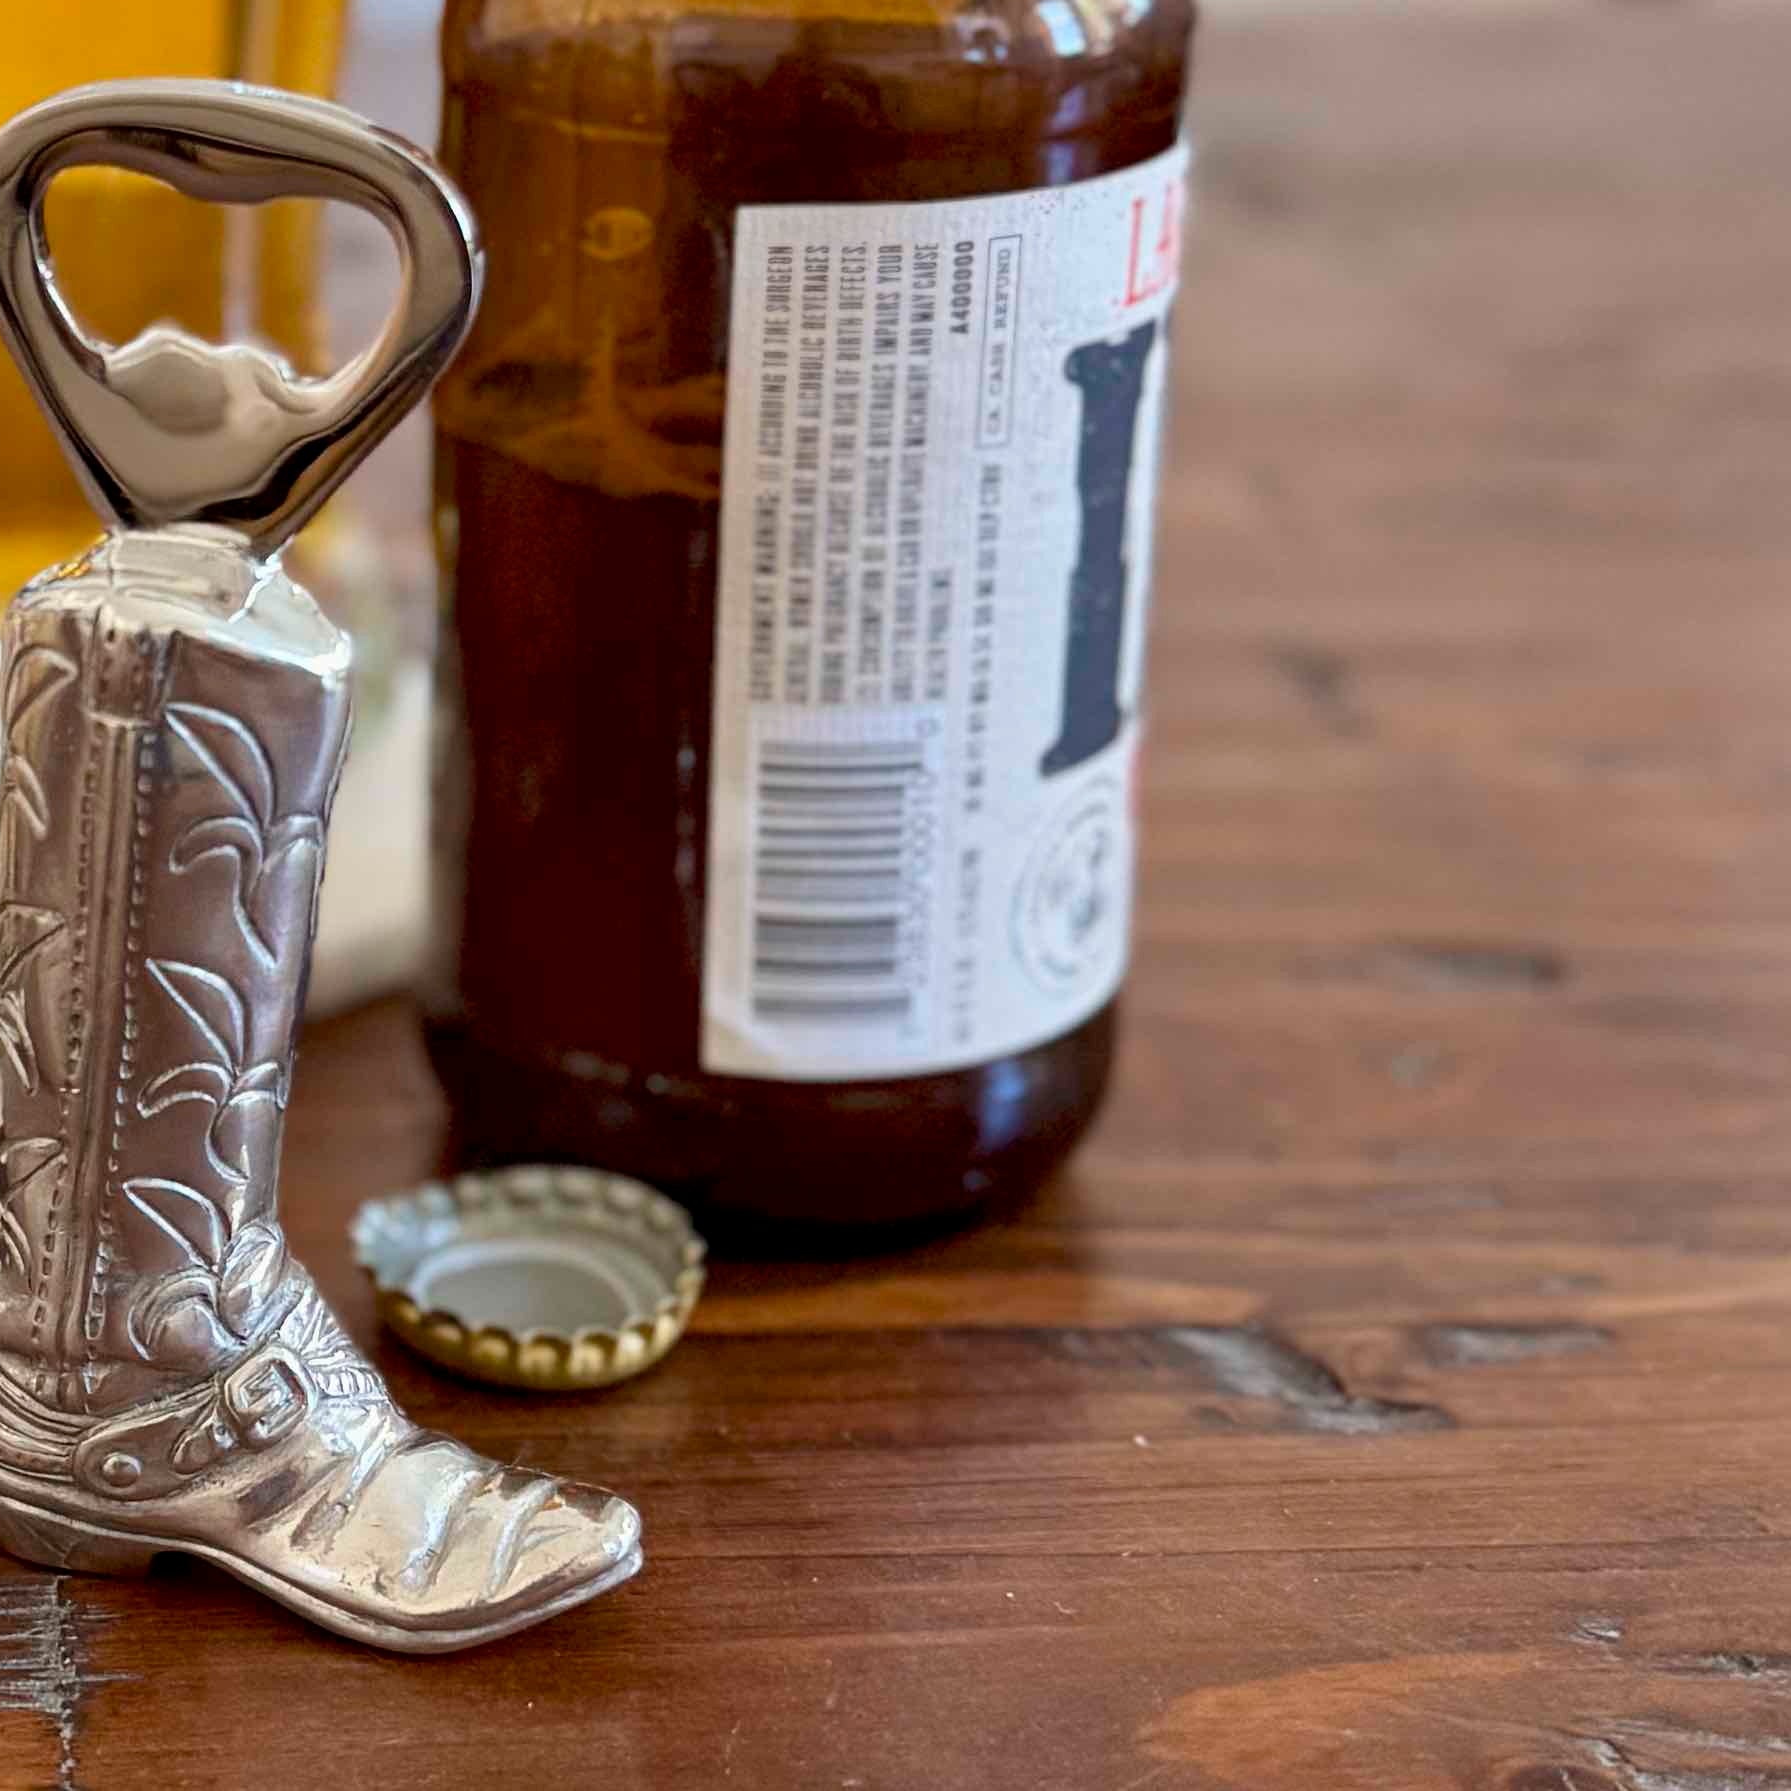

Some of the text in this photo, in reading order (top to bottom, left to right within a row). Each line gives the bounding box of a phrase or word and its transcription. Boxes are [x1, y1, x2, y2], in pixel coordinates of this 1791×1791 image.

[765, 245, 793, 312] SURGEON
[800, 244, 830, 330] BEVERAGES
[838, 240, 867, 310] DEFECTS.
[876, 244, 902, 283] YOUR
[911, 242, 939, 289] CAUSE
[949, 239, 974, 334] A400000
[992, 247, 1012, 329] REFUND
[763, 318, 789, 344] THE
[872, 291, 900, 354] IMPAIRS
[909, 293, 935, 323] MAY
[762, 350, 788, 367] TO
[835, 316, 862, 361] BIRTH
[907, 327, 933, 355] AND
[796, 336, 825, 419] ALCOHOLIC
[834, 368, 860, 384] OF
[988, 341, 1005, 397] CASH
[759, 373, 787, 457] ACCORDING
[832, 392, 858, 426] RISK
[867, 363, 896, 448] BEVERAGES
[794, 426, 821, 471] DRINK
